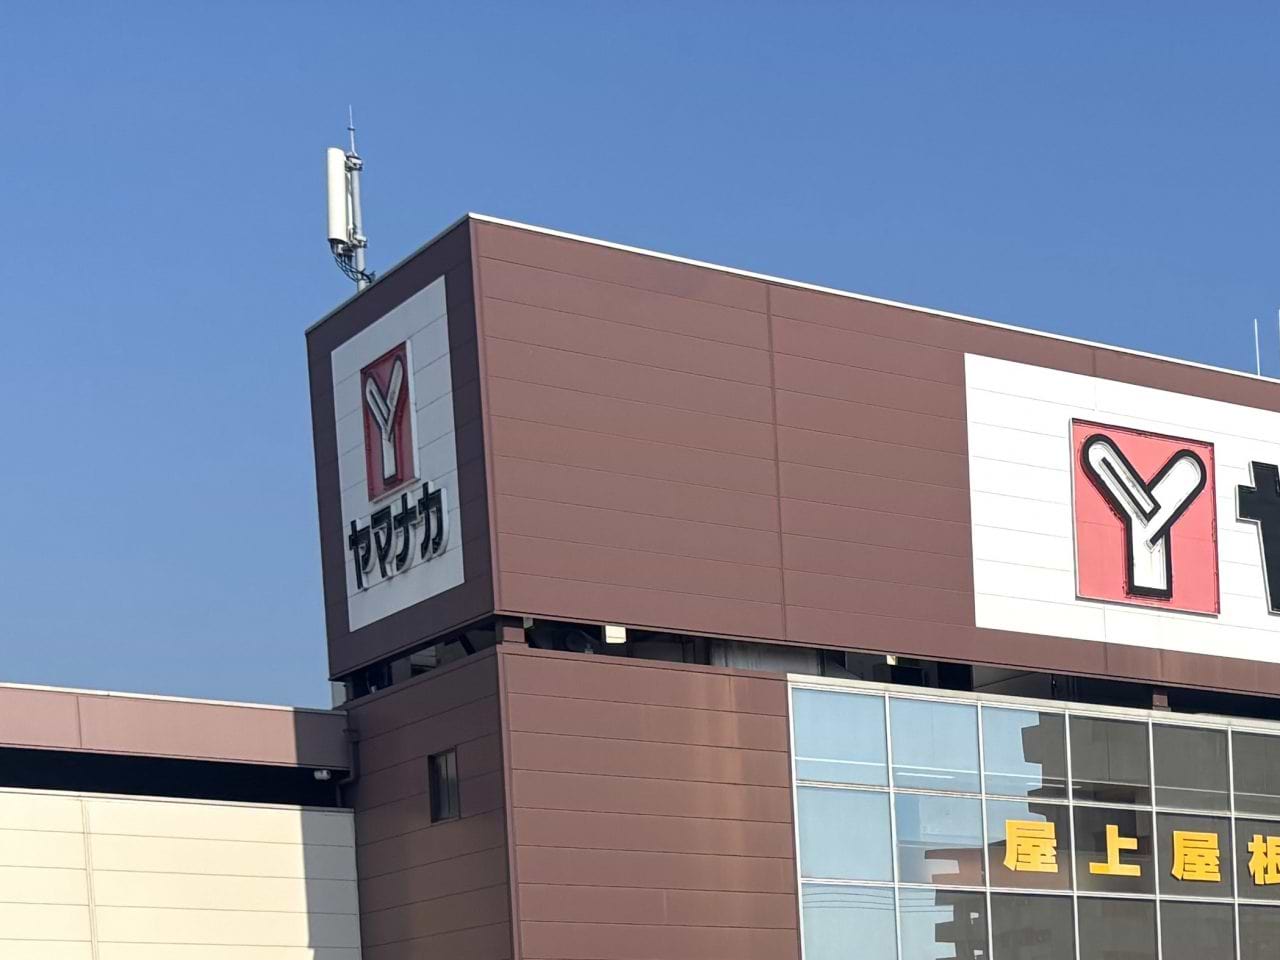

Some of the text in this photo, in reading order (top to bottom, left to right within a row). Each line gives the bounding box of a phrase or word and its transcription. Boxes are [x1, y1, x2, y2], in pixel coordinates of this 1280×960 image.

[366, 355, 404, 484] Y
[349, 481, 449, 591] ヤマナカ
[1081, 433, 1207, 599] Y
